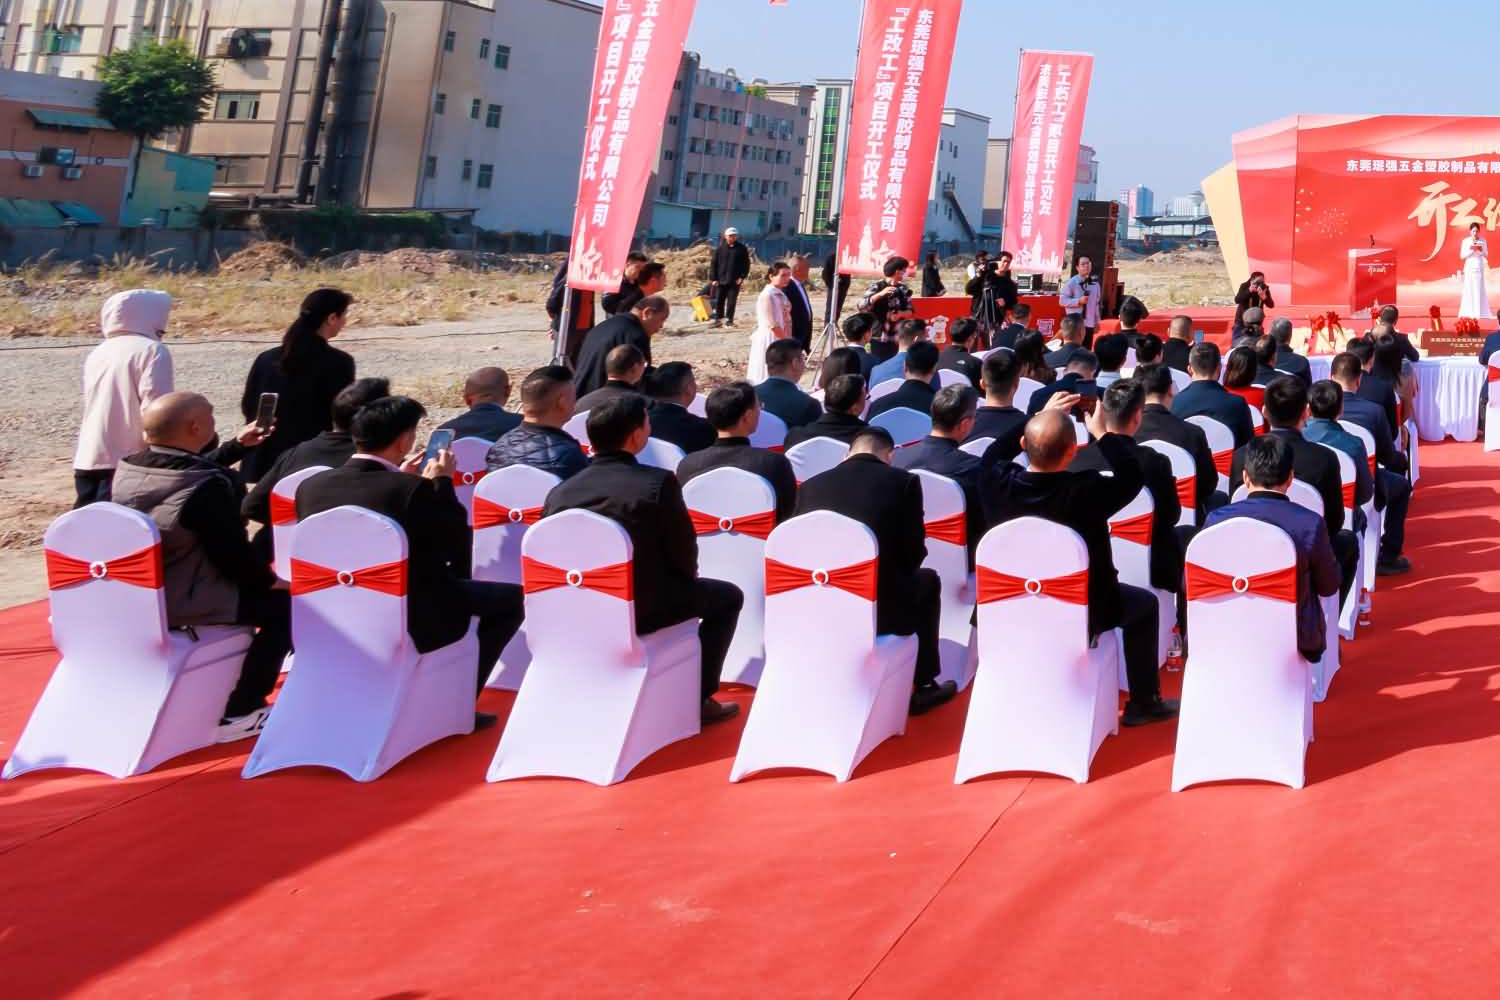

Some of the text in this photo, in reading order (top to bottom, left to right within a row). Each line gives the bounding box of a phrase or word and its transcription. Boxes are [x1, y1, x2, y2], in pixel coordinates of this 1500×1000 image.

[881, 9, 934, 232] 东莞珉强五金塑胶制品有限公司
